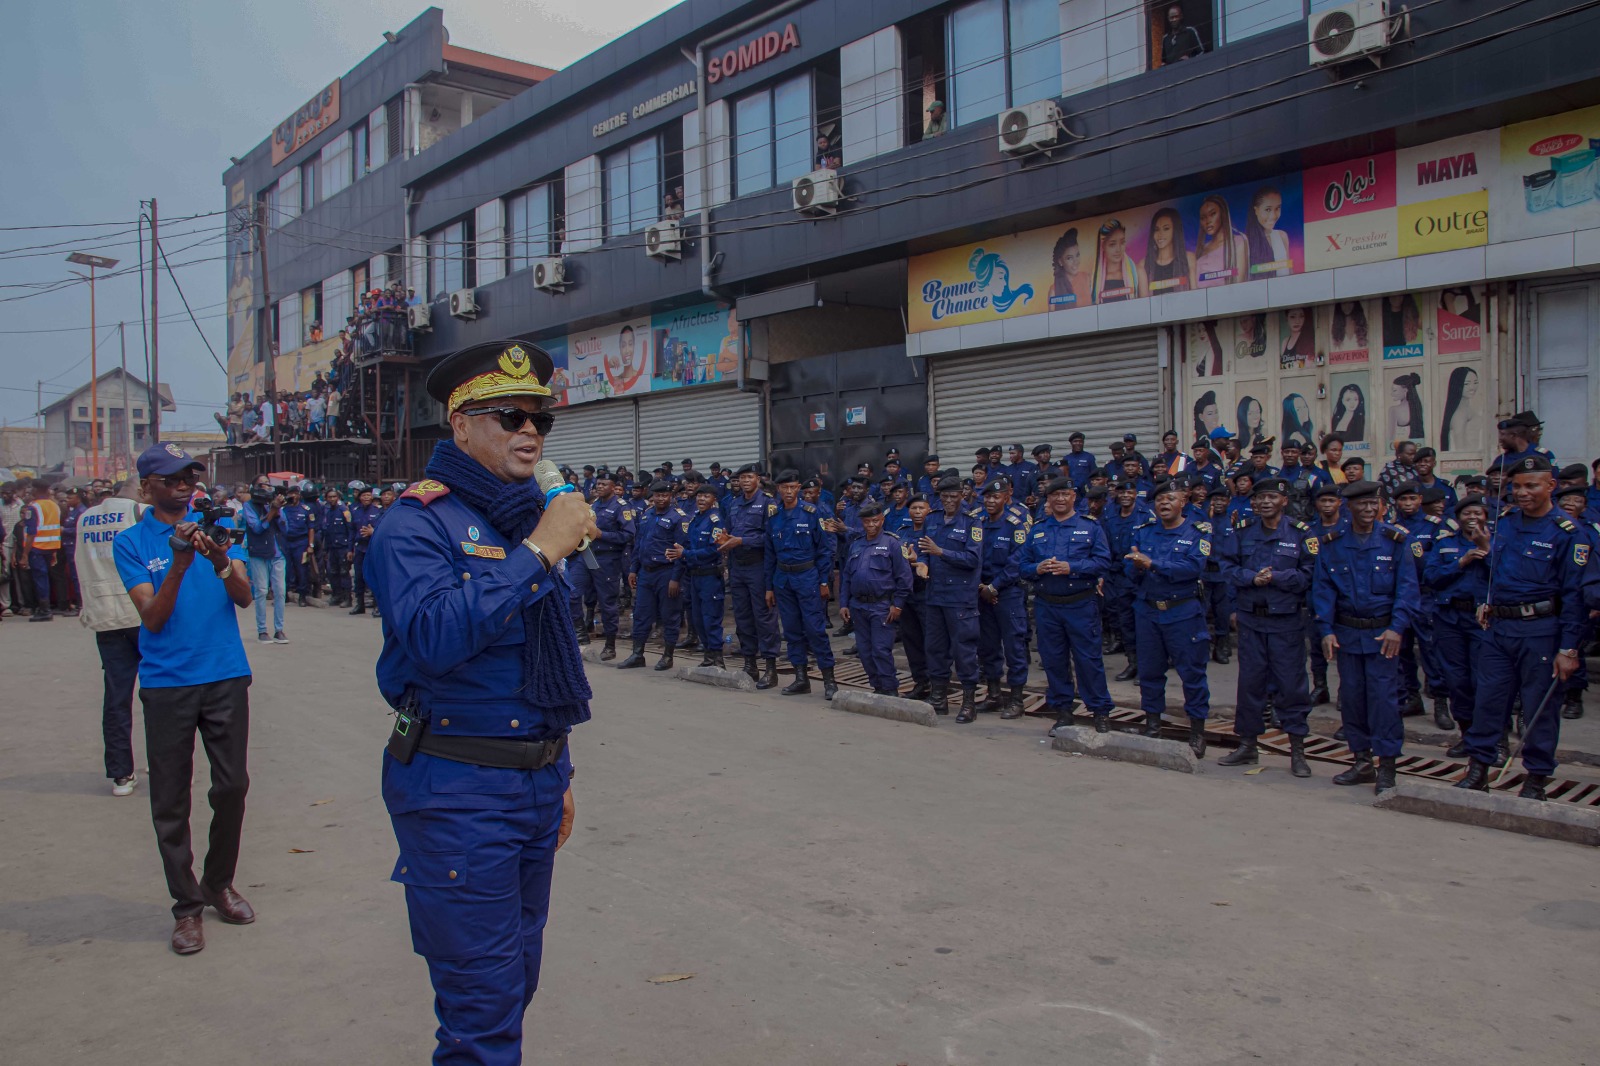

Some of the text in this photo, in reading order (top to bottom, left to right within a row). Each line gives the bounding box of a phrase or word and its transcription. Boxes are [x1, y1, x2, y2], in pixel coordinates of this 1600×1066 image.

[708, 23, 800, 84] SOMIDA
[592, 80, 697, 138] CENTRE COMMERCIAL
[1417, 152, 1478, 186] MAYA
[1324, 159, 1377, 213] Ola!
[1353, 193, 1375, 205] Braid
[1415, 210, 1488, 237] Outre
[1466, 227, 1485, 235] BRAID
[1352, 241, 1387, 252] COLLECTION
[922, 280, 977, 303] Bonne
[932, 294, 988, 320] Chance
[671, 310, 720, 331] Africlass
[1441, 323, 1481, 341] Sanza
[574, 336, 602, 355] Smile
[1387, 347, 1422, 358] MINA
[83, 513, 124, 527] PRESSE
[84, 530, 119, 543] POLICE
[1531, 540, 1553, 549] POLICE
